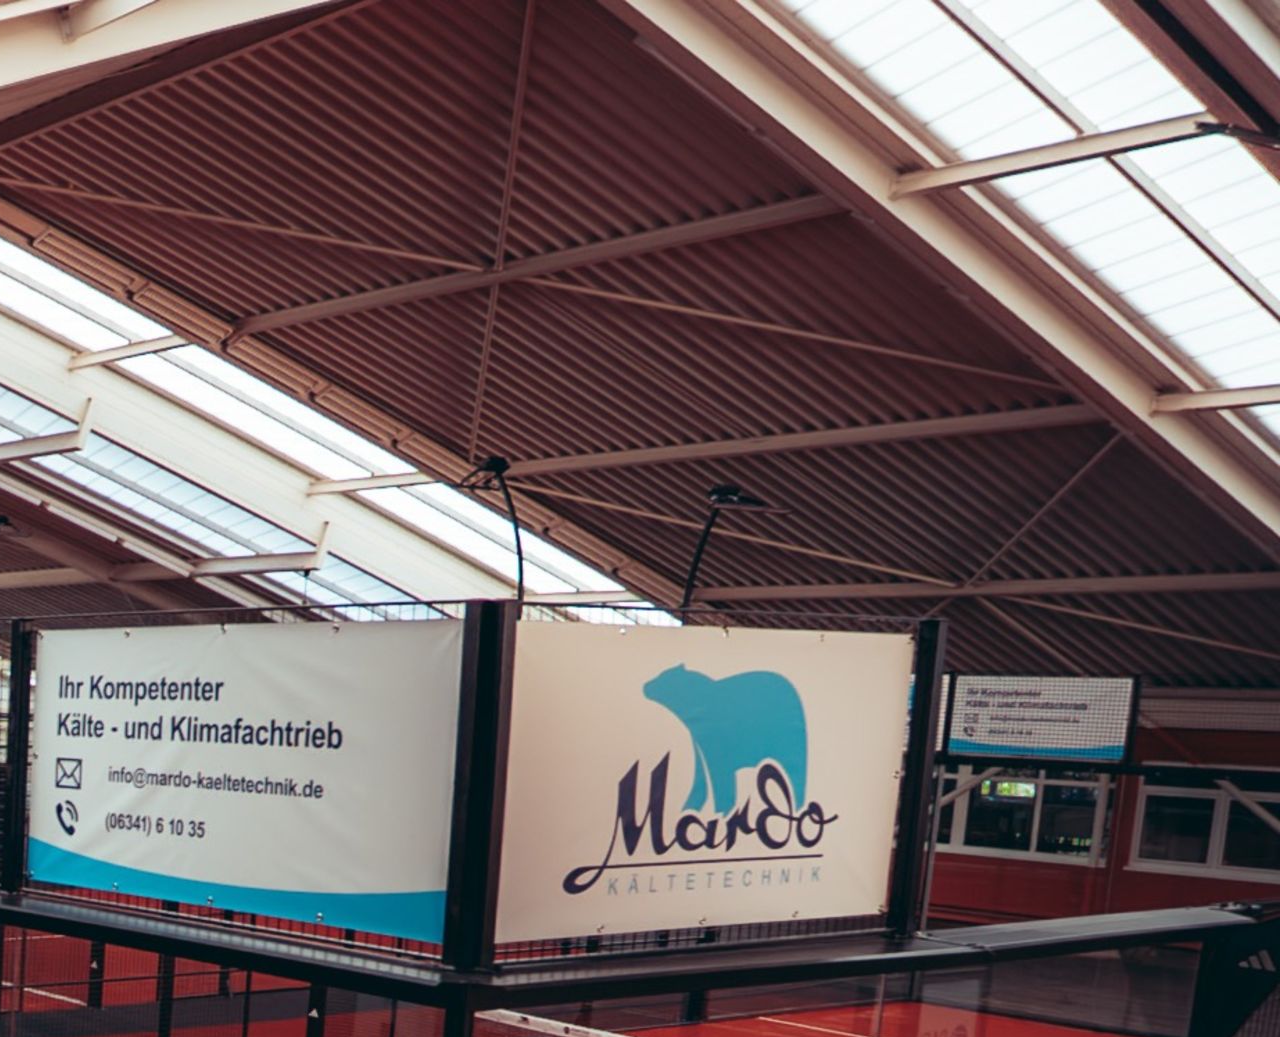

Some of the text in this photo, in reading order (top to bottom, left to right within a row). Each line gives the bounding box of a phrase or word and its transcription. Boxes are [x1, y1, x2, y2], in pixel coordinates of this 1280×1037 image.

[58, 675, 225, 706] Ihr Kompetenter
[57, 712, 105, 739] Kälte
[124, 715, 162, 741] und
[171, 716, 343, 749] Klimafachtrieb
[108, 766, 324, 799] info@mardo-kaeltetechnik.de
[105, 812, 206, 839] (06341) 6 10 35
[562, 751, 839, 896] Mardo
[607, 866, 822, 897] KÄLTETECHNIK
